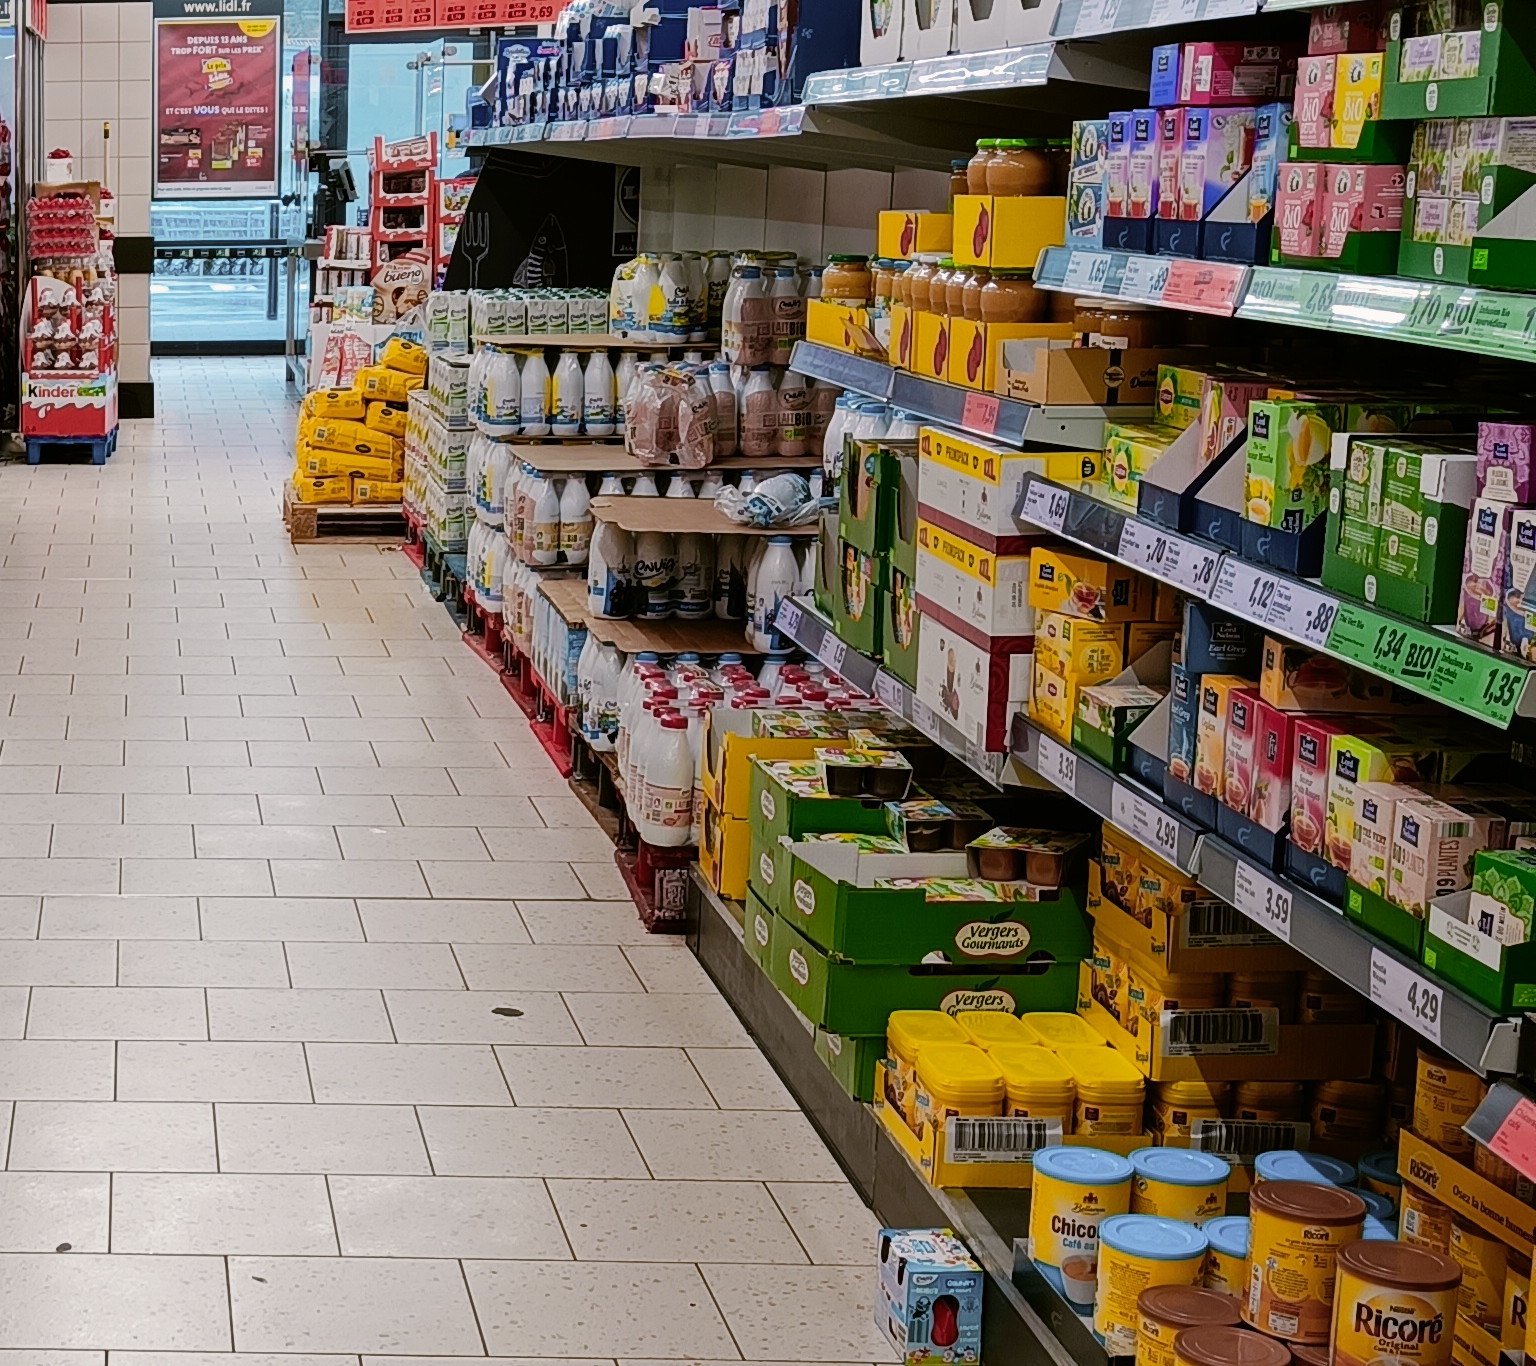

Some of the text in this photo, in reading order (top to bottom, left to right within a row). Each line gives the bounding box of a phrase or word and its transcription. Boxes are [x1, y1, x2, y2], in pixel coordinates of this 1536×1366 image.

[184, 0, 252, 13] www.lidl.fr
[529, 6, 553, 19] 2,69
[171, 47, 192, 55] TROP
[193, 46, 216, 55] FORT
[187, 35, 247, 44] DEPUIS 13 ANS
[193, 105, 220, 115] VOUS
[383, 268, 421, 284] bueno
[1088, 258, 1108, 285] 1,69
[28, 384, 75, 398] Kinder
[1048, 493, 1066, 521] 1,69
[1249, 576, 1275, 609] 1,12
[1306, 602, 1334, 633] -,88
[1208, 644, 1247, 654] Earl Grey
[1373, 625, 1441, 680] 1,34 BIO!
[1482, 668, 1521, 707] 1,35
[1058, 752, 1074, 780] 3,39
[1156, 816, 1177, 849] 2,99
[1438, 840, 1460, 877] PLANTES
[1265, 888, 1289, 923] 3,59
[970, 924, 1020, 941] Vergers
[961, 937, 1025, 951] Gourmands
[954, 992, 1004, 1010] Vergers
[1407, 981, 1438, 1023] 4,29
[1410, 1159, 1440, 1188] Ricoré
[1452, 1185, 1505, 1225] Osez la bonne
[1063, 1238, 1082, 1249] Café
[1302, 1229, 1330, 1242] Ricoré
[1354, 1301, 1443, 1345] Ricoré
[1378, 1338, 1420, 1351] Original
